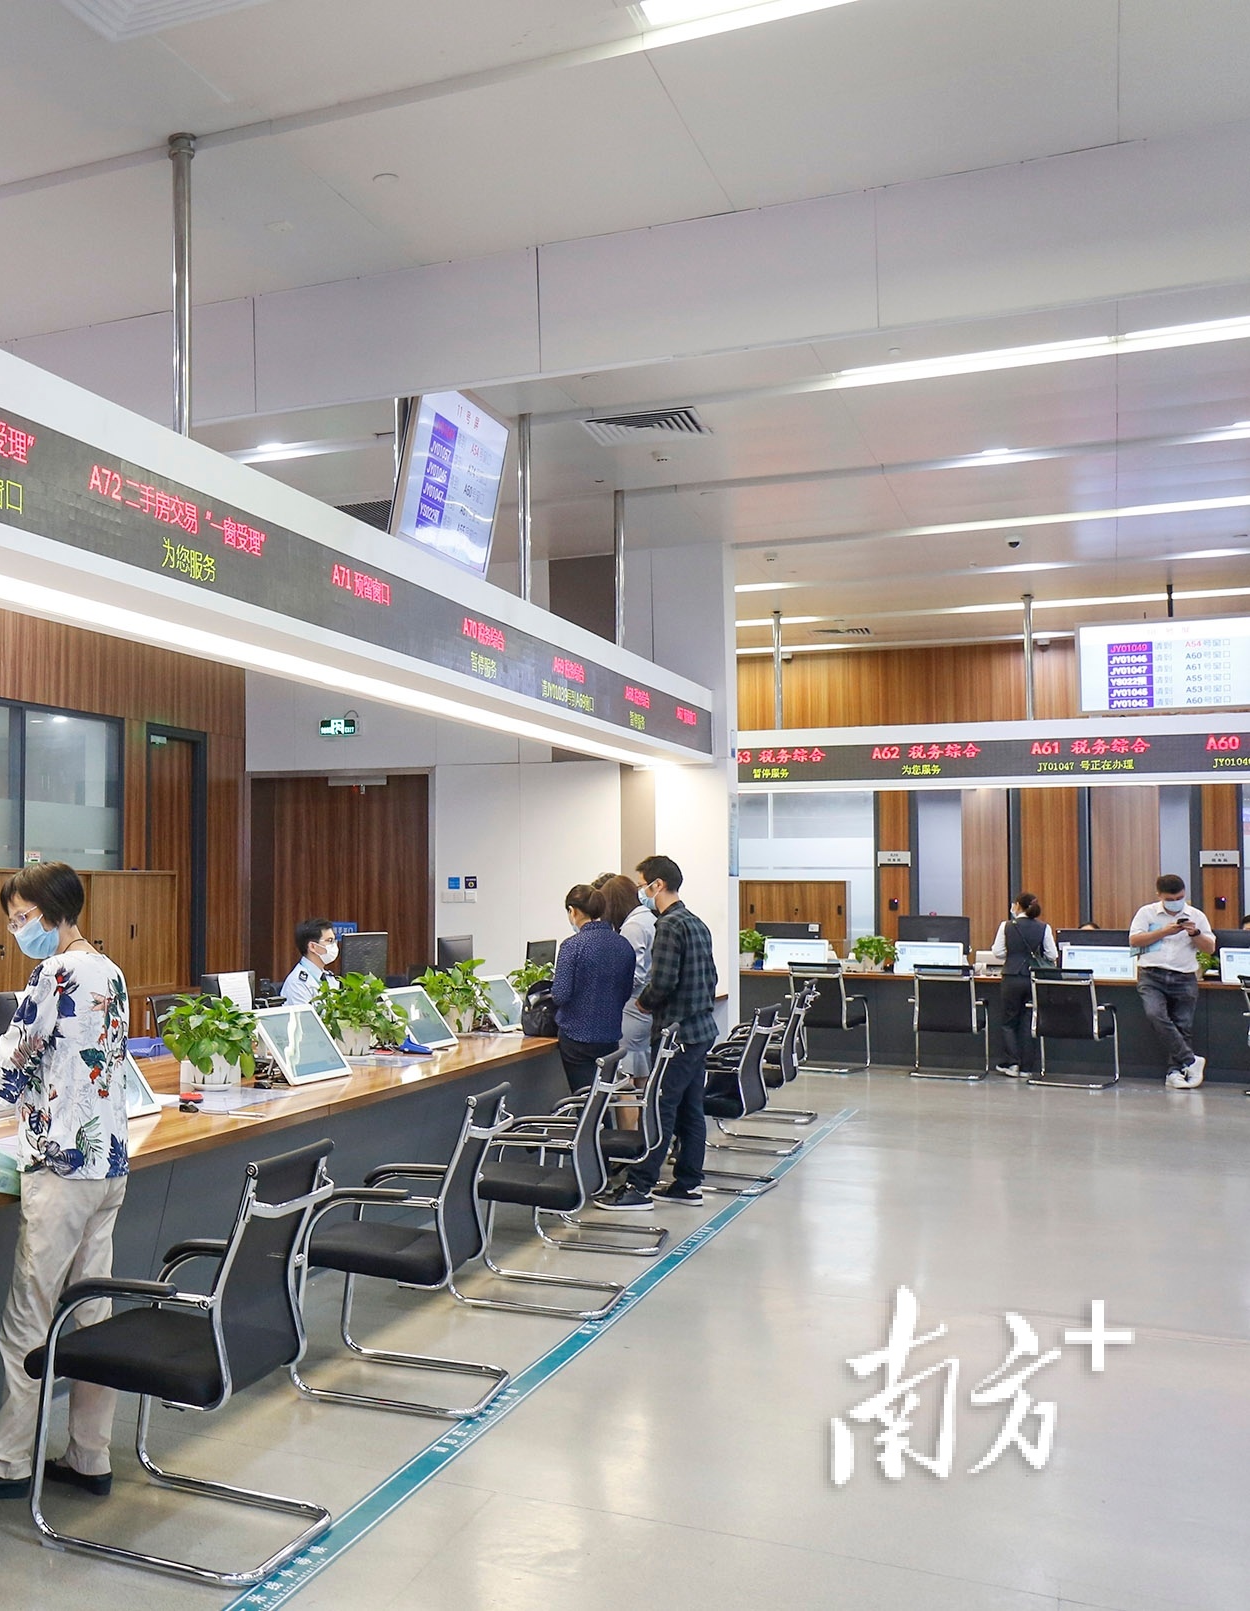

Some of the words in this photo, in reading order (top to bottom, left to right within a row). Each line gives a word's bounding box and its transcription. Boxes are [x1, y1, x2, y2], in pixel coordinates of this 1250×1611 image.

[89, 464, 122, 503] A72
[125, 479, 198, 535] 二手房交易
[161, 536, 216, 583] 为您服务
[332, 564, 352, 590] A71
[354, 571, 390, 607] 预留窗口
[463, 618, 477, 639] A70
[871, 746, 900, 760] A62
[908, 743, 981, 760] 税务综合
[1030, 741, 1061, 755] A61
[1071, 737, 1151, 755] 税务综合
[1205, 735, 1240, 751] A60
[758, 748, 826, 763] 税务综合
[752, 768, 789, 779] 暂停服务
[901, 764, 942, 776] 为您服务
[1037, 762, 1075, 772] JY01047
[1080, 759, 1135, 771] 号正在办理
